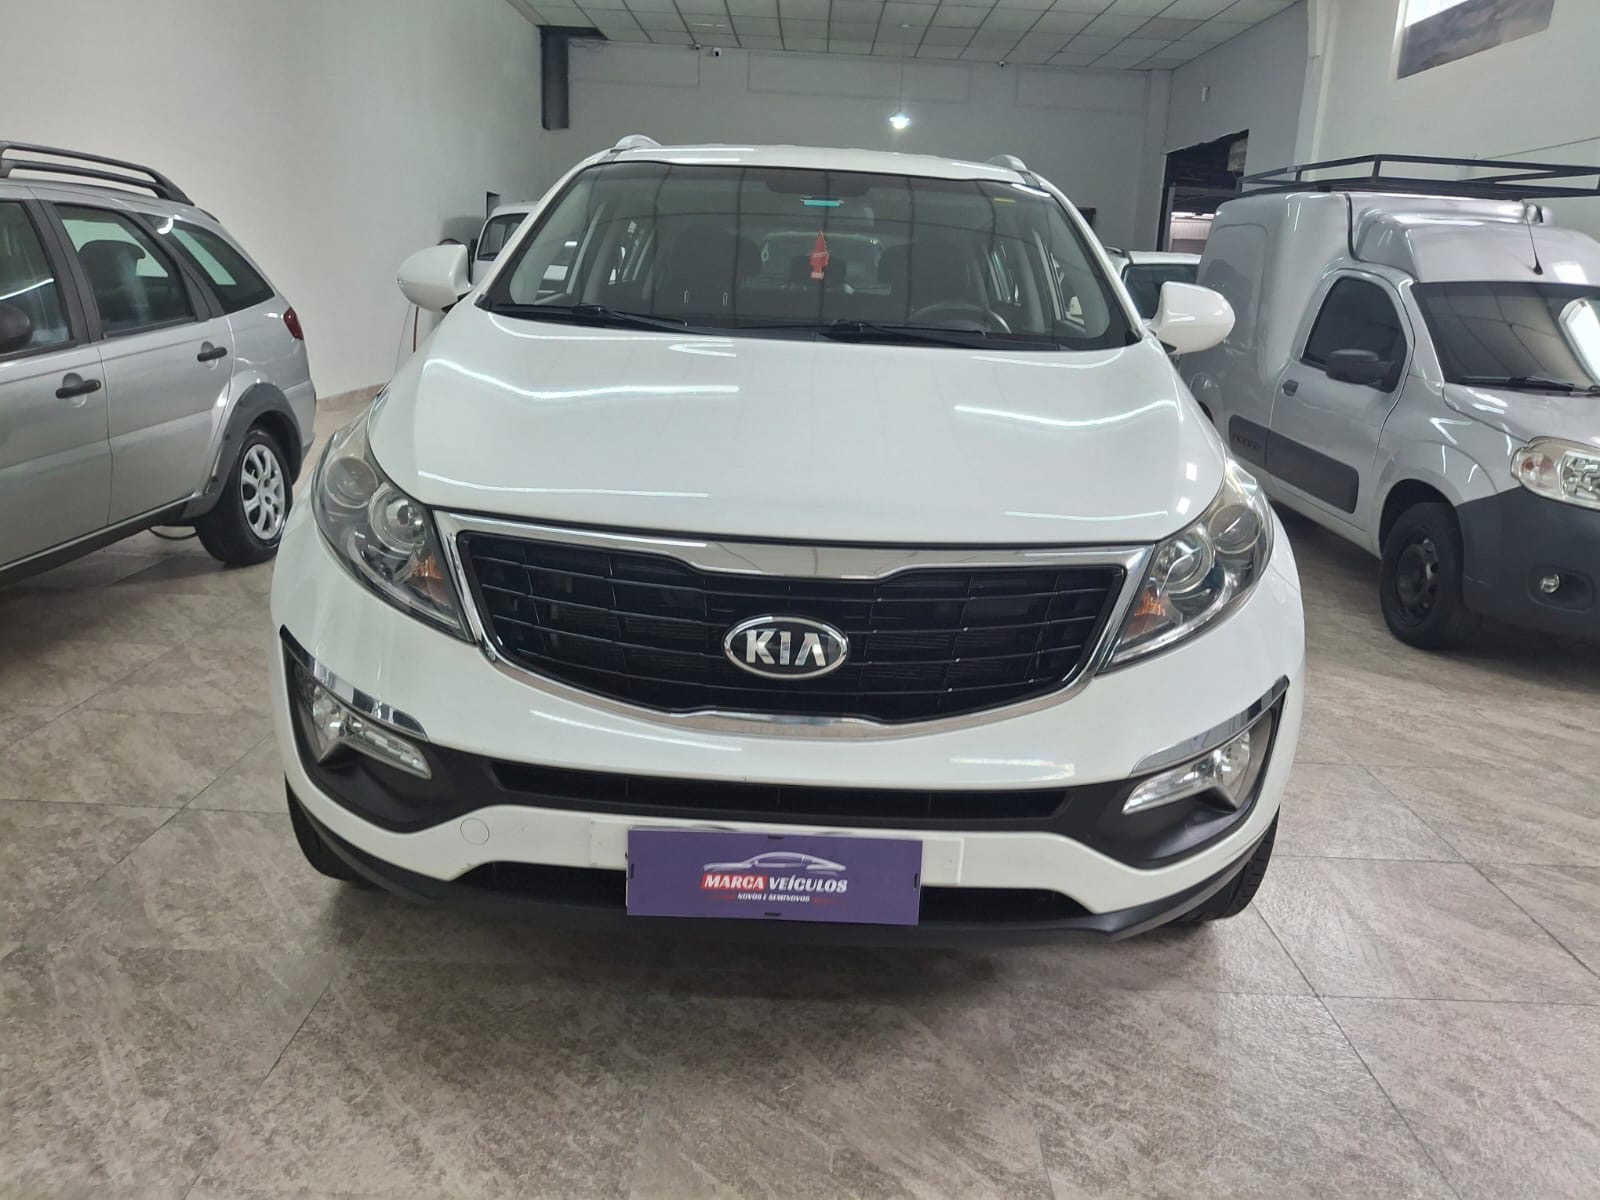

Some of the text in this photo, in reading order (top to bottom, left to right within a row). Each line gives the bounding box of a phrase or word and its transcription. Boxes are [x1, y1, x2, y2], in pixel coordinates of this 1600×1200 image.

[746, 629, 826, 667] KIA
[704, 874, 848, 893] MARCA VEÍCULOS
[737, 892, 762, 901] NOVOS
